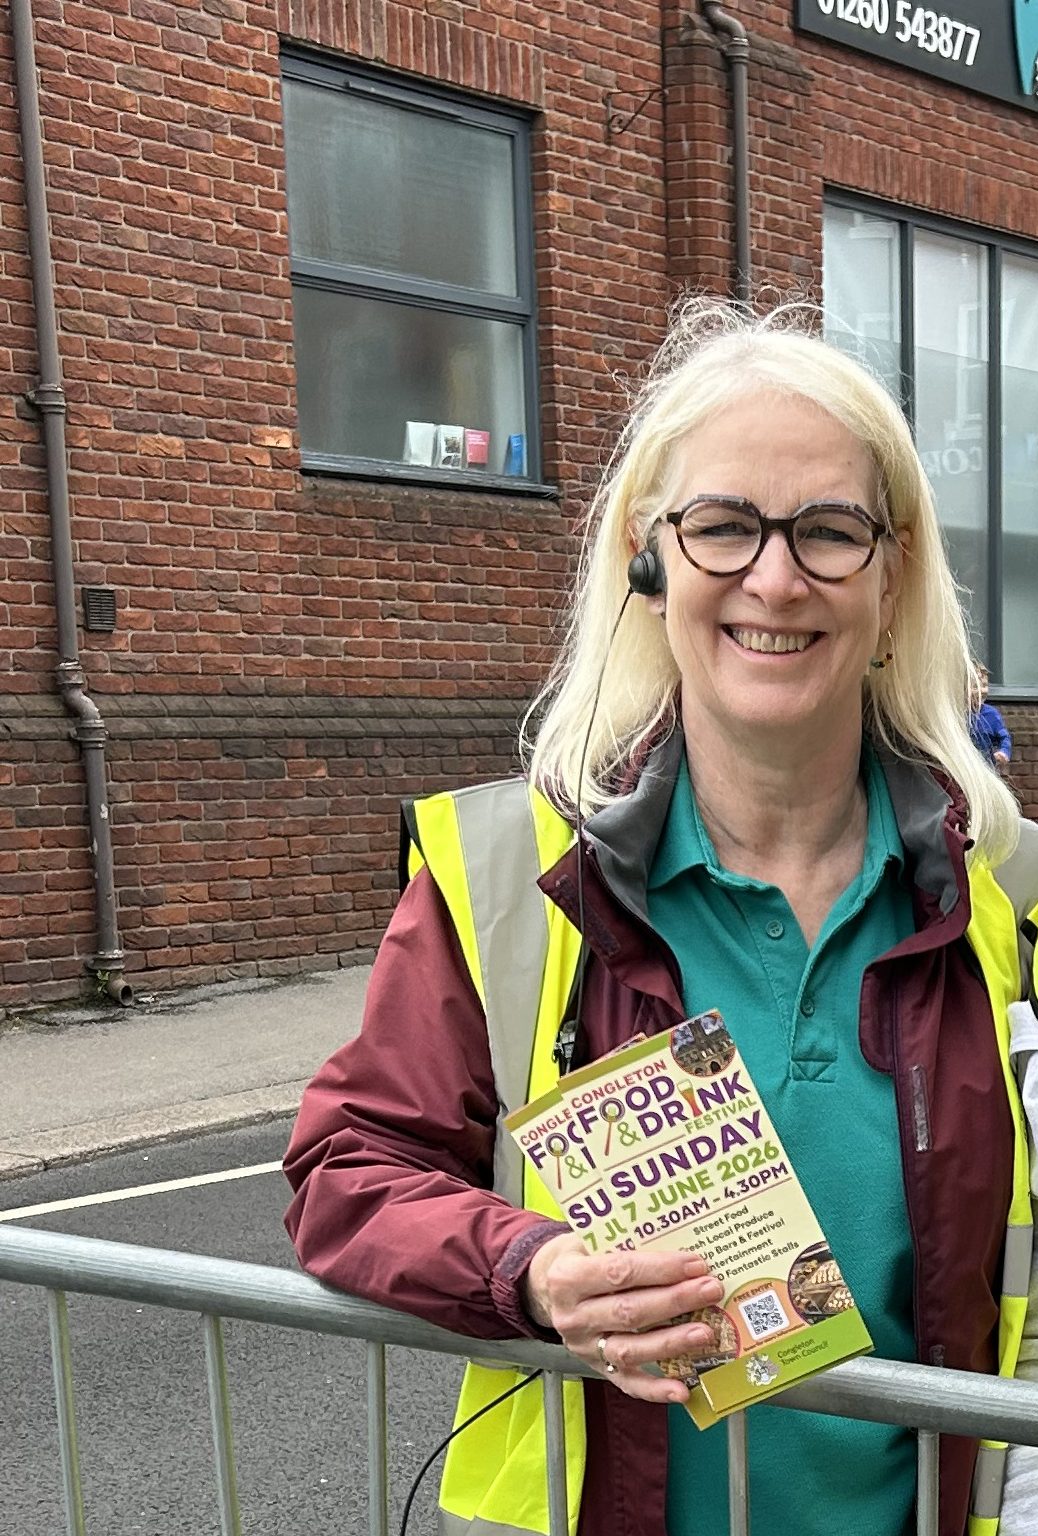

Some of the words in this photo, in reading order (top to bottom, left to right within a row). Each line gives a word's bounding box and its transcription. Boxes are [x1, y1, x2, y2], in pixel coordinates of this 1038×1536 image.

[896, 1, 981, 66] 543877
[571, 1059, 667, 1109] CONGLETON
[576, 1075, 675, 1135] FOOD
[685, 1096, 757, 1135] FESTIVAL
[519, 1108, 573, 1147] CONGLE
[617, 1121, 641, 1147] &
[564, 1155, 588, 1179] &
[611, 1110, 763, 1199] SUNDAY
[621, 1201, 637, 1222] 7
[647, 1169, 714, 1213] JUNE
[717, 1140, 780, 1182] 2026
[634, 1196, 710, 1239] 10.30AM
[724, 1161, 789, 1199] 4.30PM
[568, 1188, 612, 1229] SU
[692, 1217, 725, 1236] Street
[724, 1204, 749, 1223] Food
[706, 1225, 734, 1244] Local
[733, 1209, 775, 1233] Produce
[582, 1231, 598, 1252] 7
[706, 1237, 774, 1273] ntertainment
[714, 1240, 738, 1255] Bars
[738, 1234, 748, 1244] &
[746, 1216, 786, 1240] Festival
[725, 1253, 772, 1279] Fantastic
[770, 1240, 800, 1259] Stalls
[777, 1338, 816, 1359] Congleton
[782, 1352, 802, 1366] Town
[801, 1340, 829, 1357] Council
